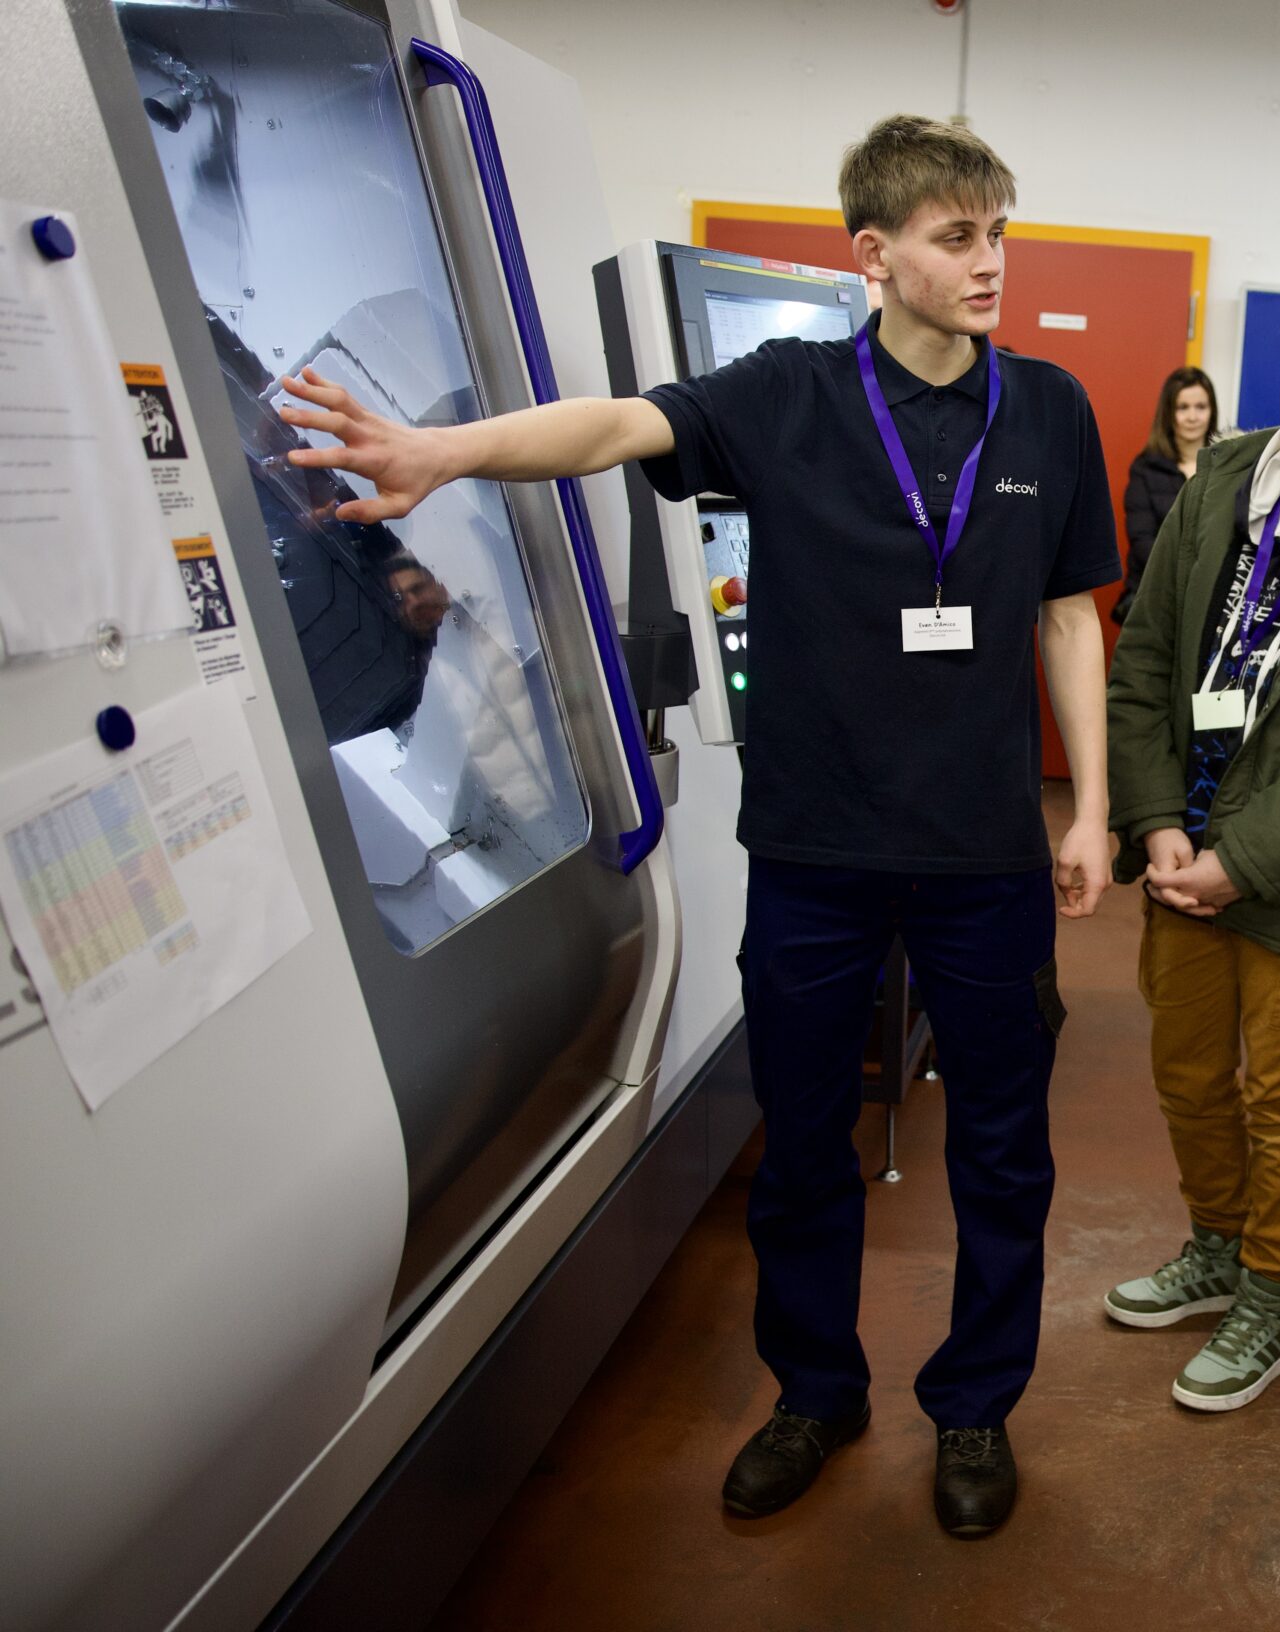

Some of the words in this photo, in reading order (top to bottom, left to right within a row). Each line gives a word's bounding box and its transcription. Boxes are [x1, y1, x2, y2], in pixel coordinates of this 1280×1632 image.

[995, 477, 1038, 497] décovi
[906, 491, 929, 527] décovi
[1242, 601, 1256, 632] décovi
